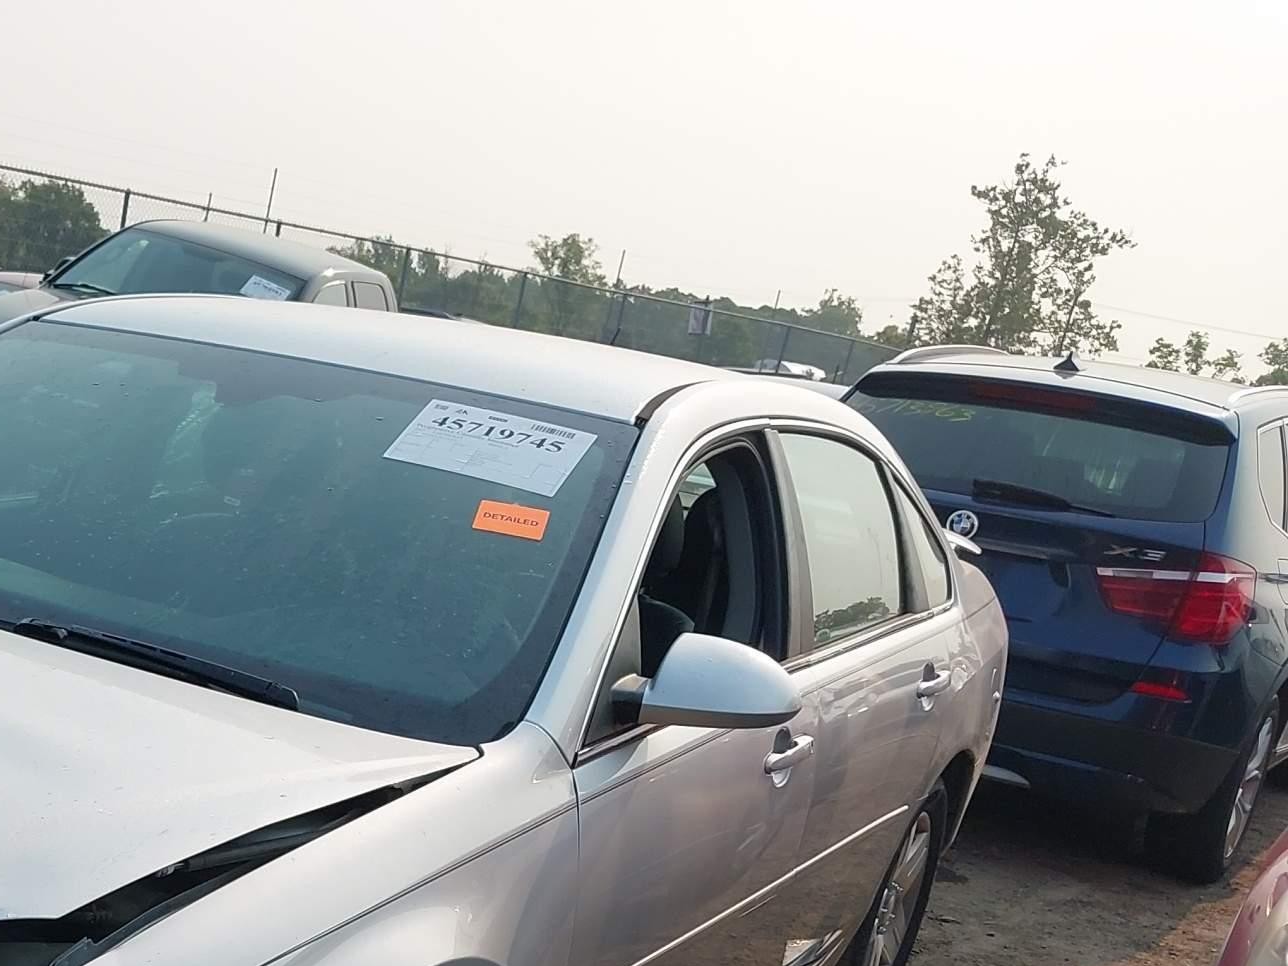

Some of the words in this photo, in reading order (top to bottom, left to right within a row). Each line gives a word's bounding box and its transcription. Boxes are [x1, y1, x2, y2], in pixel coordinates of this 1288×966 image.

[431, 415, 566, 454] 45719745
[482, 511, 540, 528] DETAILED
[1104, 543, 1167, 562] X3
